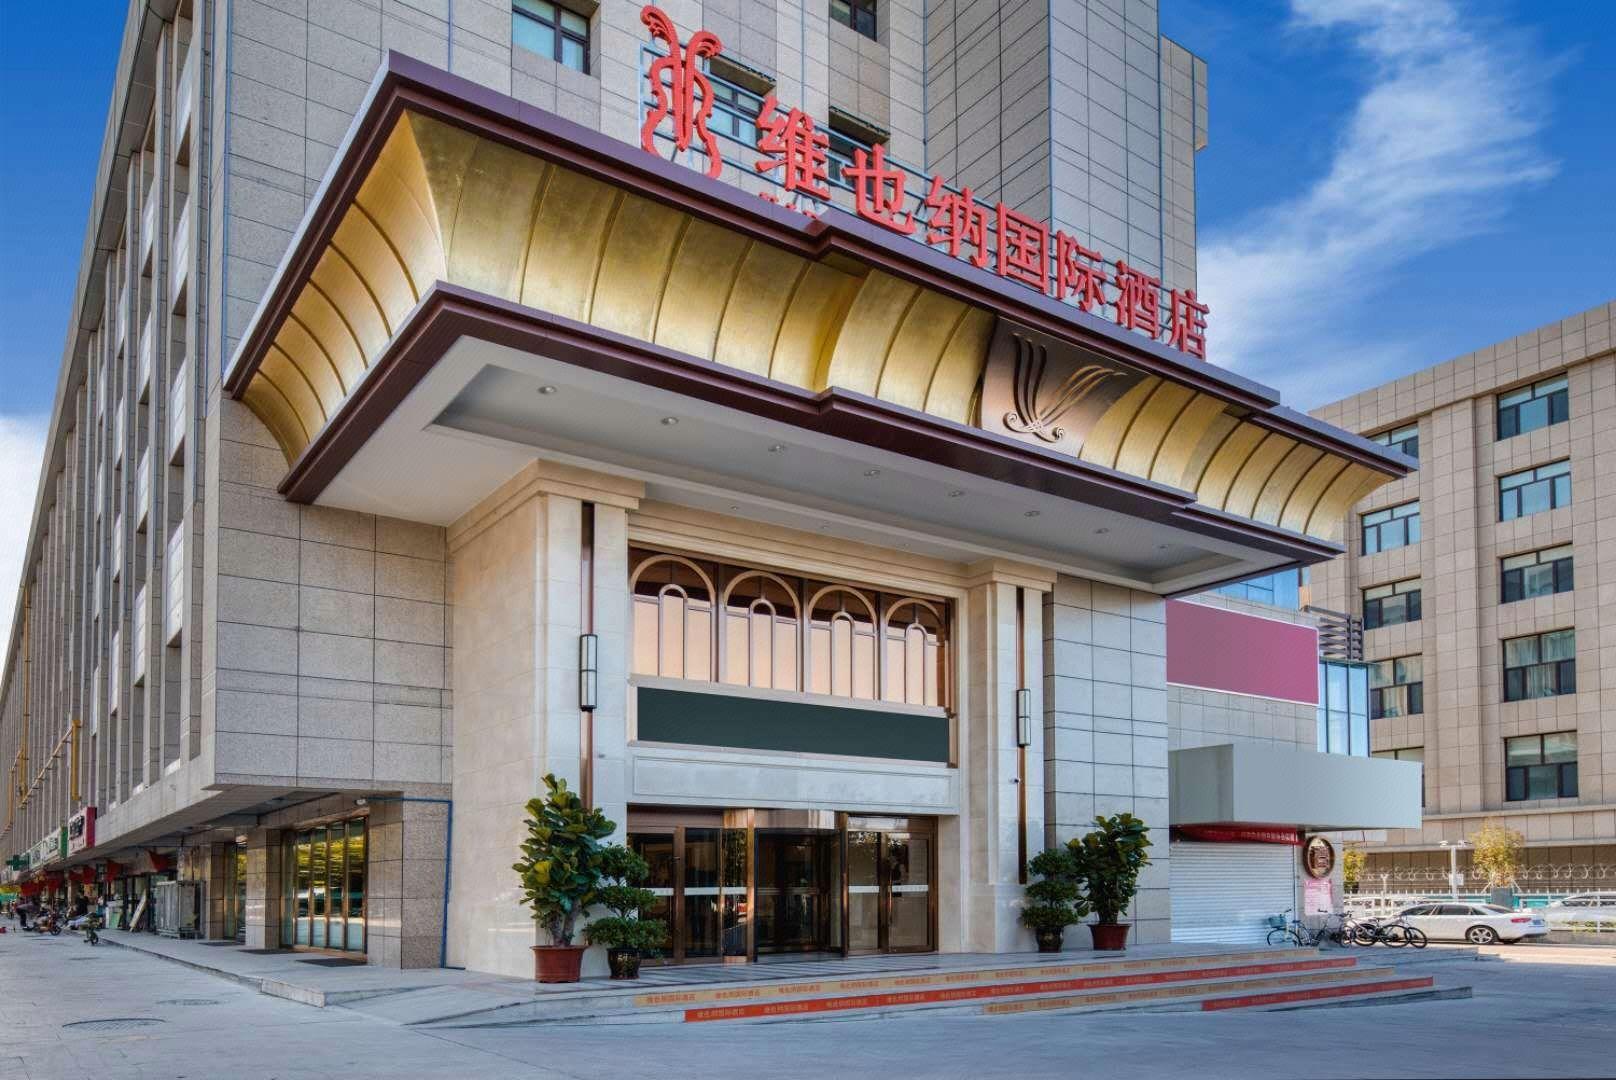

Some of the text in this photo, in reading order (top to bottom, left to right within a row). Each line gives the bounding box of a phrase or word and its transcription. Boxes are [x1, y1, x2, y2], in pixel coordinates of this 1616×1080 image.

[756, 97, 1209, 361] 维也纳国际酒店
